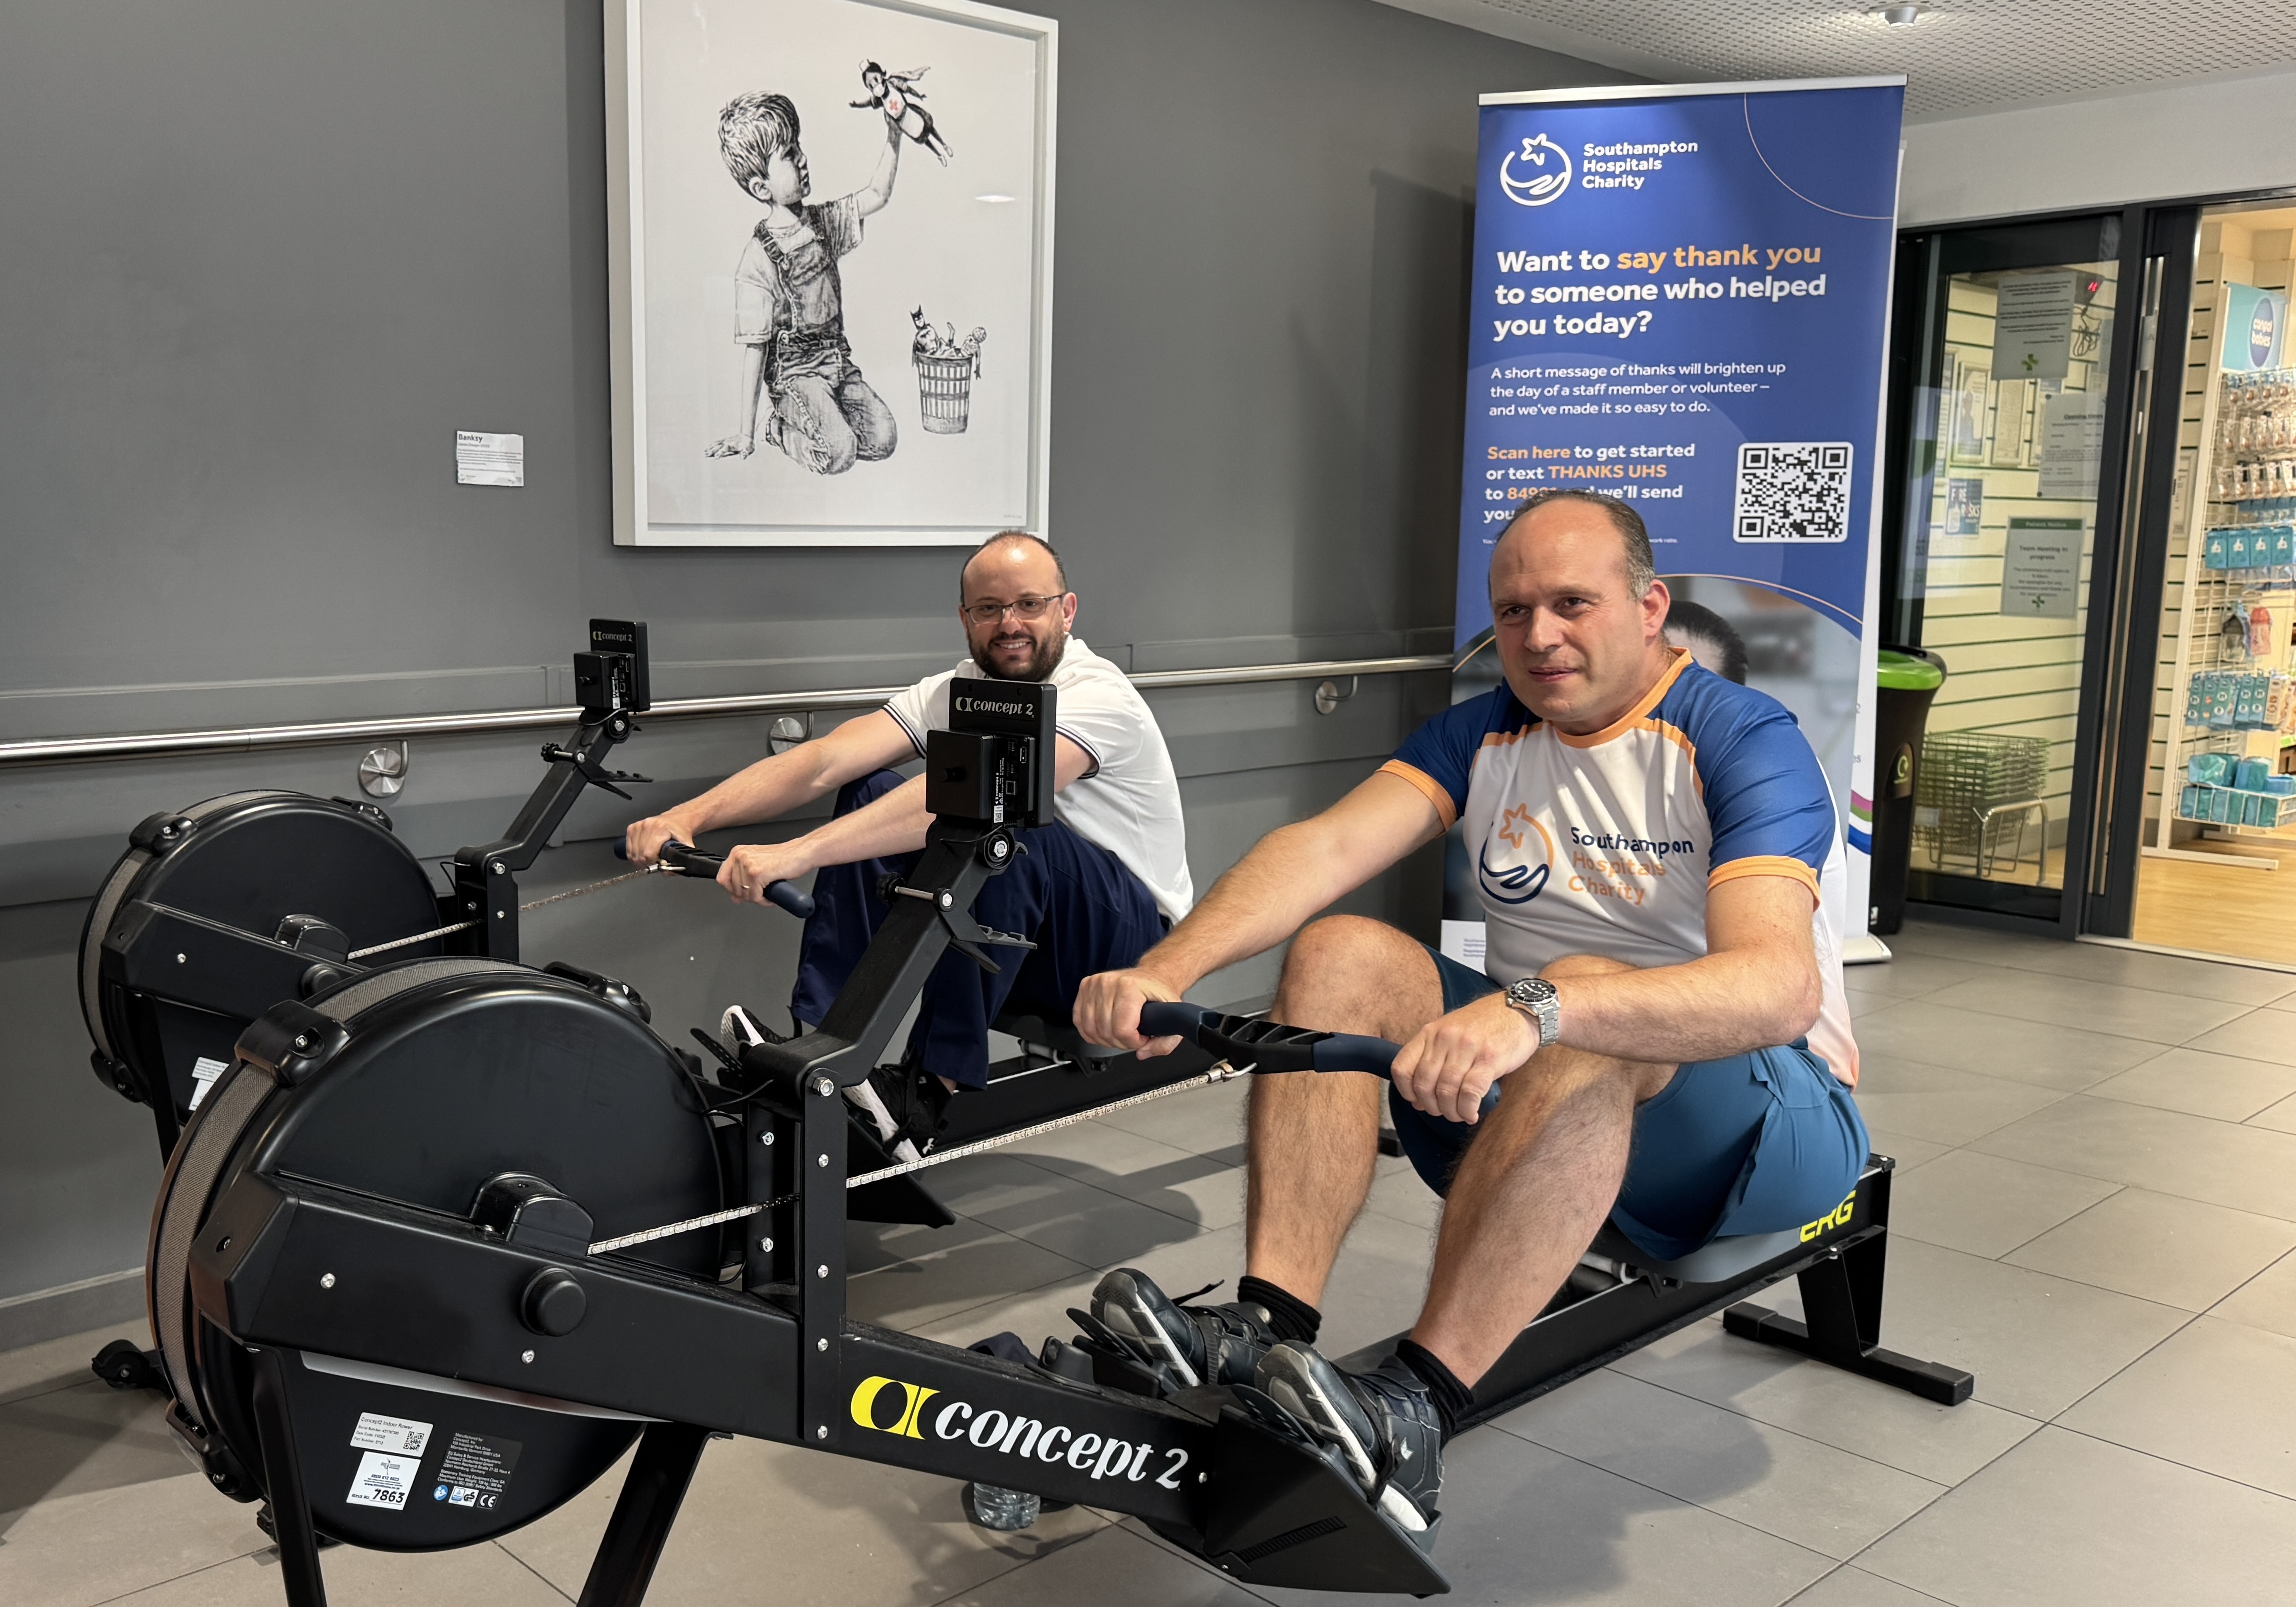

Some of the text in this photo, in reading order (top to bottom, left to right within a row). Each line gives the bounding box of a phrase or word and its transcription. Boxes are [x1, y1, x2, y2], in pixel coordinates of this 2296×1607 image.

[1583, 141, 1698, 157] Southampton
[1583, 157, 1662, 175] Hospitals
[1582, 174, 1645, 190] Charity
[1497, 244, 1821, 274] Want to say thank you
[1495, 274, 1826, 305] to someone who helped
[1493, 310, 1652, 342] you today?
[1491, 362, 1786, 380] A short message of thanks will brighten up
[1490, 386, 1514, 398] the
[1516, 385, 1542, 400] day
[1544, 384, 1560, 397] of
[1561, 387, 1570, 396] a
[1572, 383, 1607, 396] staff
[1608, 383, 1668, 395] member
[1671, 385, 1687, 394] or
[1689, 381, 1758, 394] volunteer
[1489, 400, 1710, 416] and we've made it so easy to do.
[459, 434, 483, 443] Banksy
[1487, 443, 1695, 462] Scan here to get started
[1486, 464, 1667, 480] or text THANKS UHS
[1485, 488, 1504, 500] to
[1507, 487, 1556, 500] 849
[1641, 485, 1683, 499] send
[1483, 510, 1515, 524] you
[974, 700, 1033, 715] concept 2
[1571, 827, 1694, 859] Southampon
[1572, 851, 1667, 879] Hospitals
[1568, 875, 1645, 905] Charity
[935, 1402, 1189, 1489] concept 2
[373, 1488, 405, 1503] 7863
[480, 1494, 496, 1507] CE
